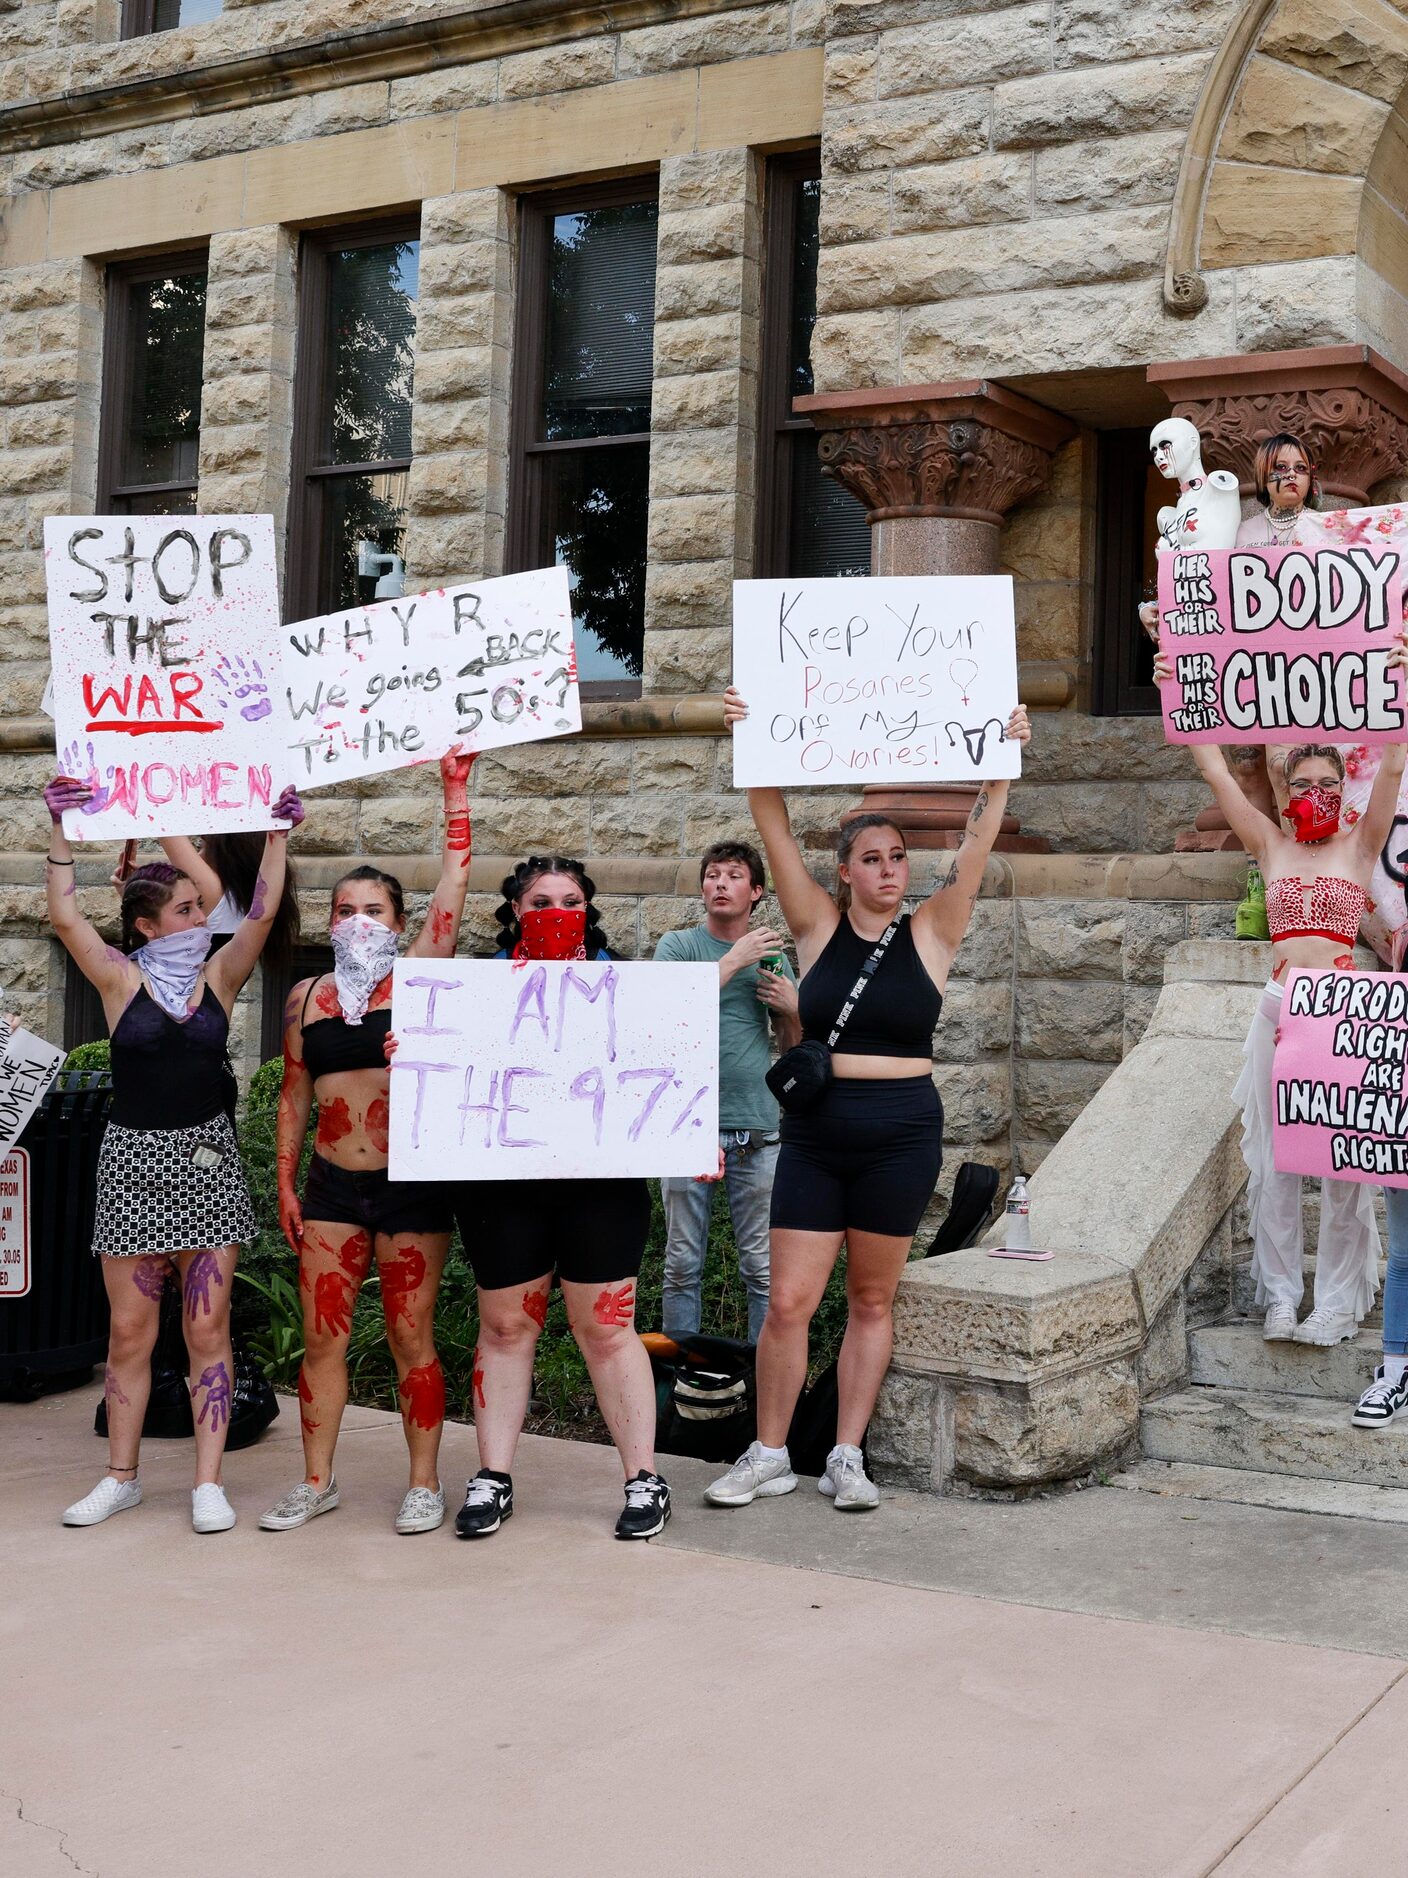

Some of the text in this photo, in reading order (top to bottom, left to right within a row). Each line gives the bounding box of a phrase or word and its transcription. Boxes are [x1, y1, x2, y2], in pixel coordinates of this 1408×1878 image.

[1173, 554, 1213, 580] HER
[1175, 579, 1216, 604] HIS
[1183, 601, 1204, 613] OR
[1229, 550, 1400, 633] BODY
[90, 611, 203, 667] THE
[290, 593, 486, 657] WHY R
[885, 603, 985, 662] Your
[1164, 610, 1224, 636] THEIR
[286, 629, 569, 720] We going BACK
[804, 666, 933, 708] Rosaries
[1177, 653, 1219, 683] HER
[82, 671, 205, 719] WAR
[1182, 681, 1219, 704] HIS
[1188, 701, 1205, 713] OR
[1221, 649, 1404, 732] CHOICE
[352, 719, 425, 760] the
[1171, 709, 1223, 732] THEIR
[800, 736, 938, 772] Ovaries!
[108, 760, 273, 817] WOMEN
[403, 966, 620, 1062] I AM
[40, 1062, 59, 1088] TUPAC
[1361, 1062, 1404, 1092] ARE
[391, 1062, 552, 1149] THE
